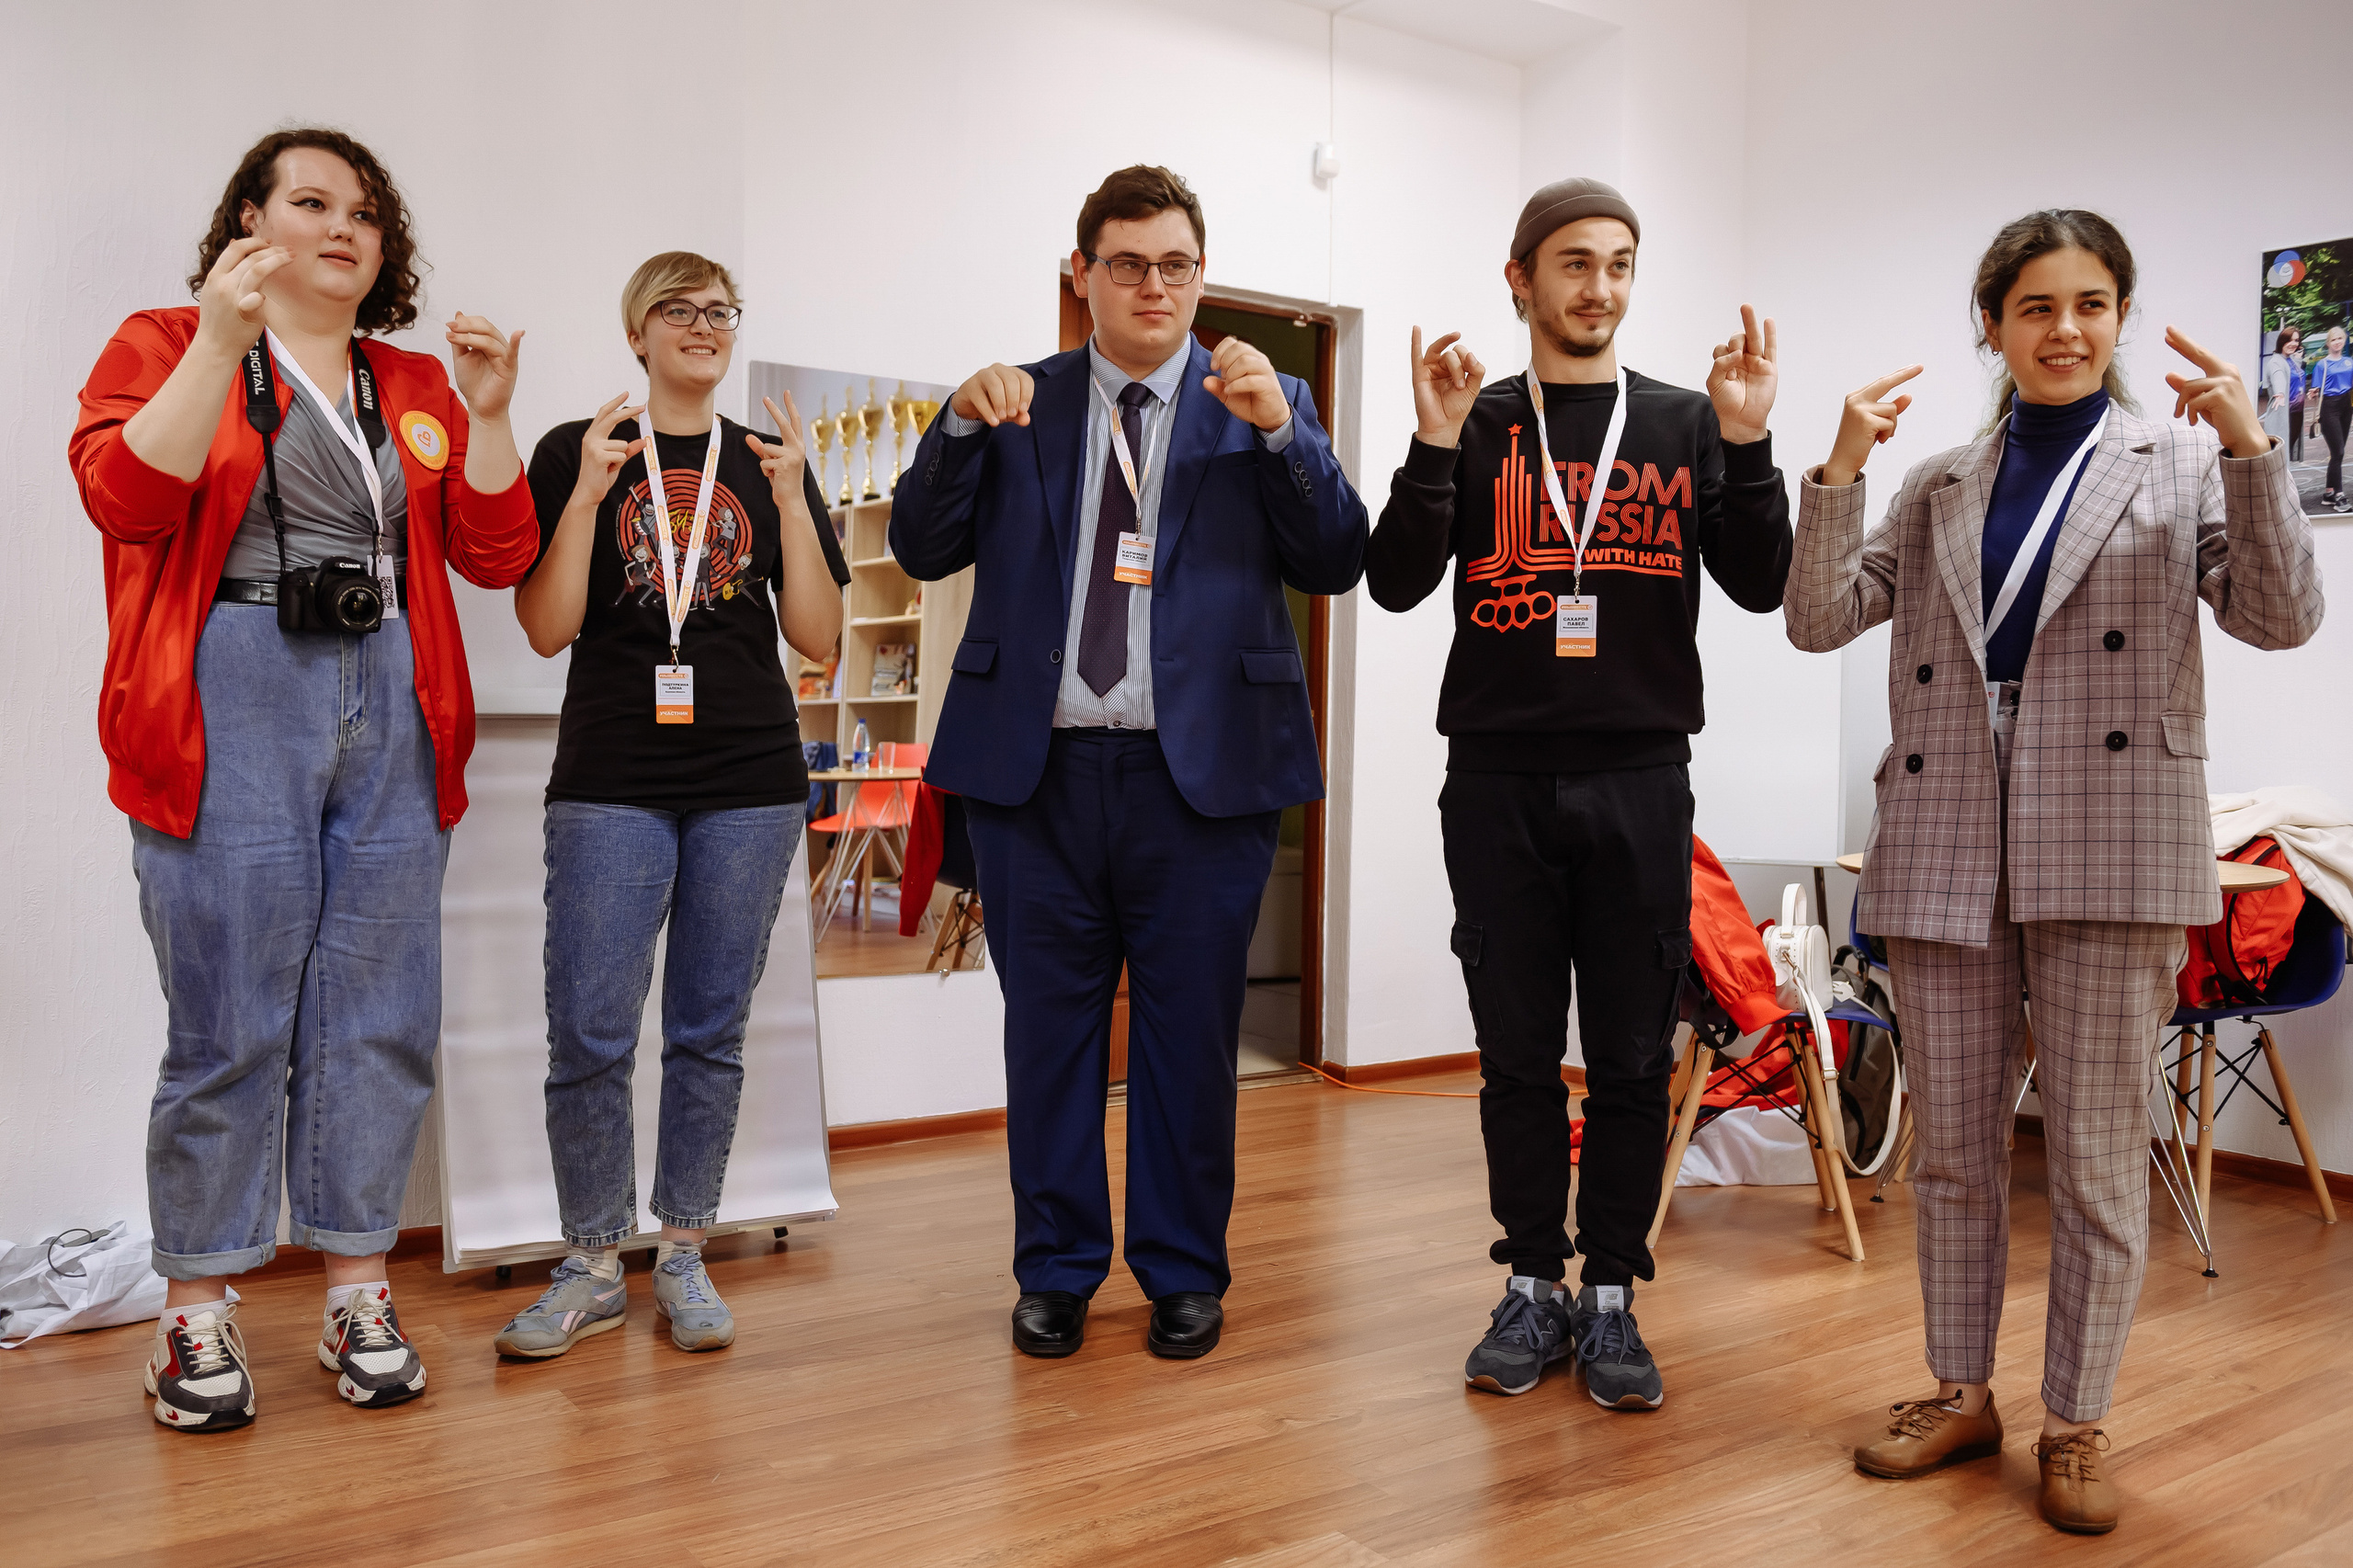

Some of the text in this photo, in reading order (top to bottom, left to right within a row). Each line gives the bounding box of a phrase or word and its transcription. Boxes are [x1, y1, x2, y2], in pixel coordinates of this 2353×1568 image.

[249, 350, 265, 395] DIGITAL
[358, 369, 374, 410] Canon
[1540, 460, 1692, 508] FROM
[1584, 548, 1683, 570] WITH HATE
